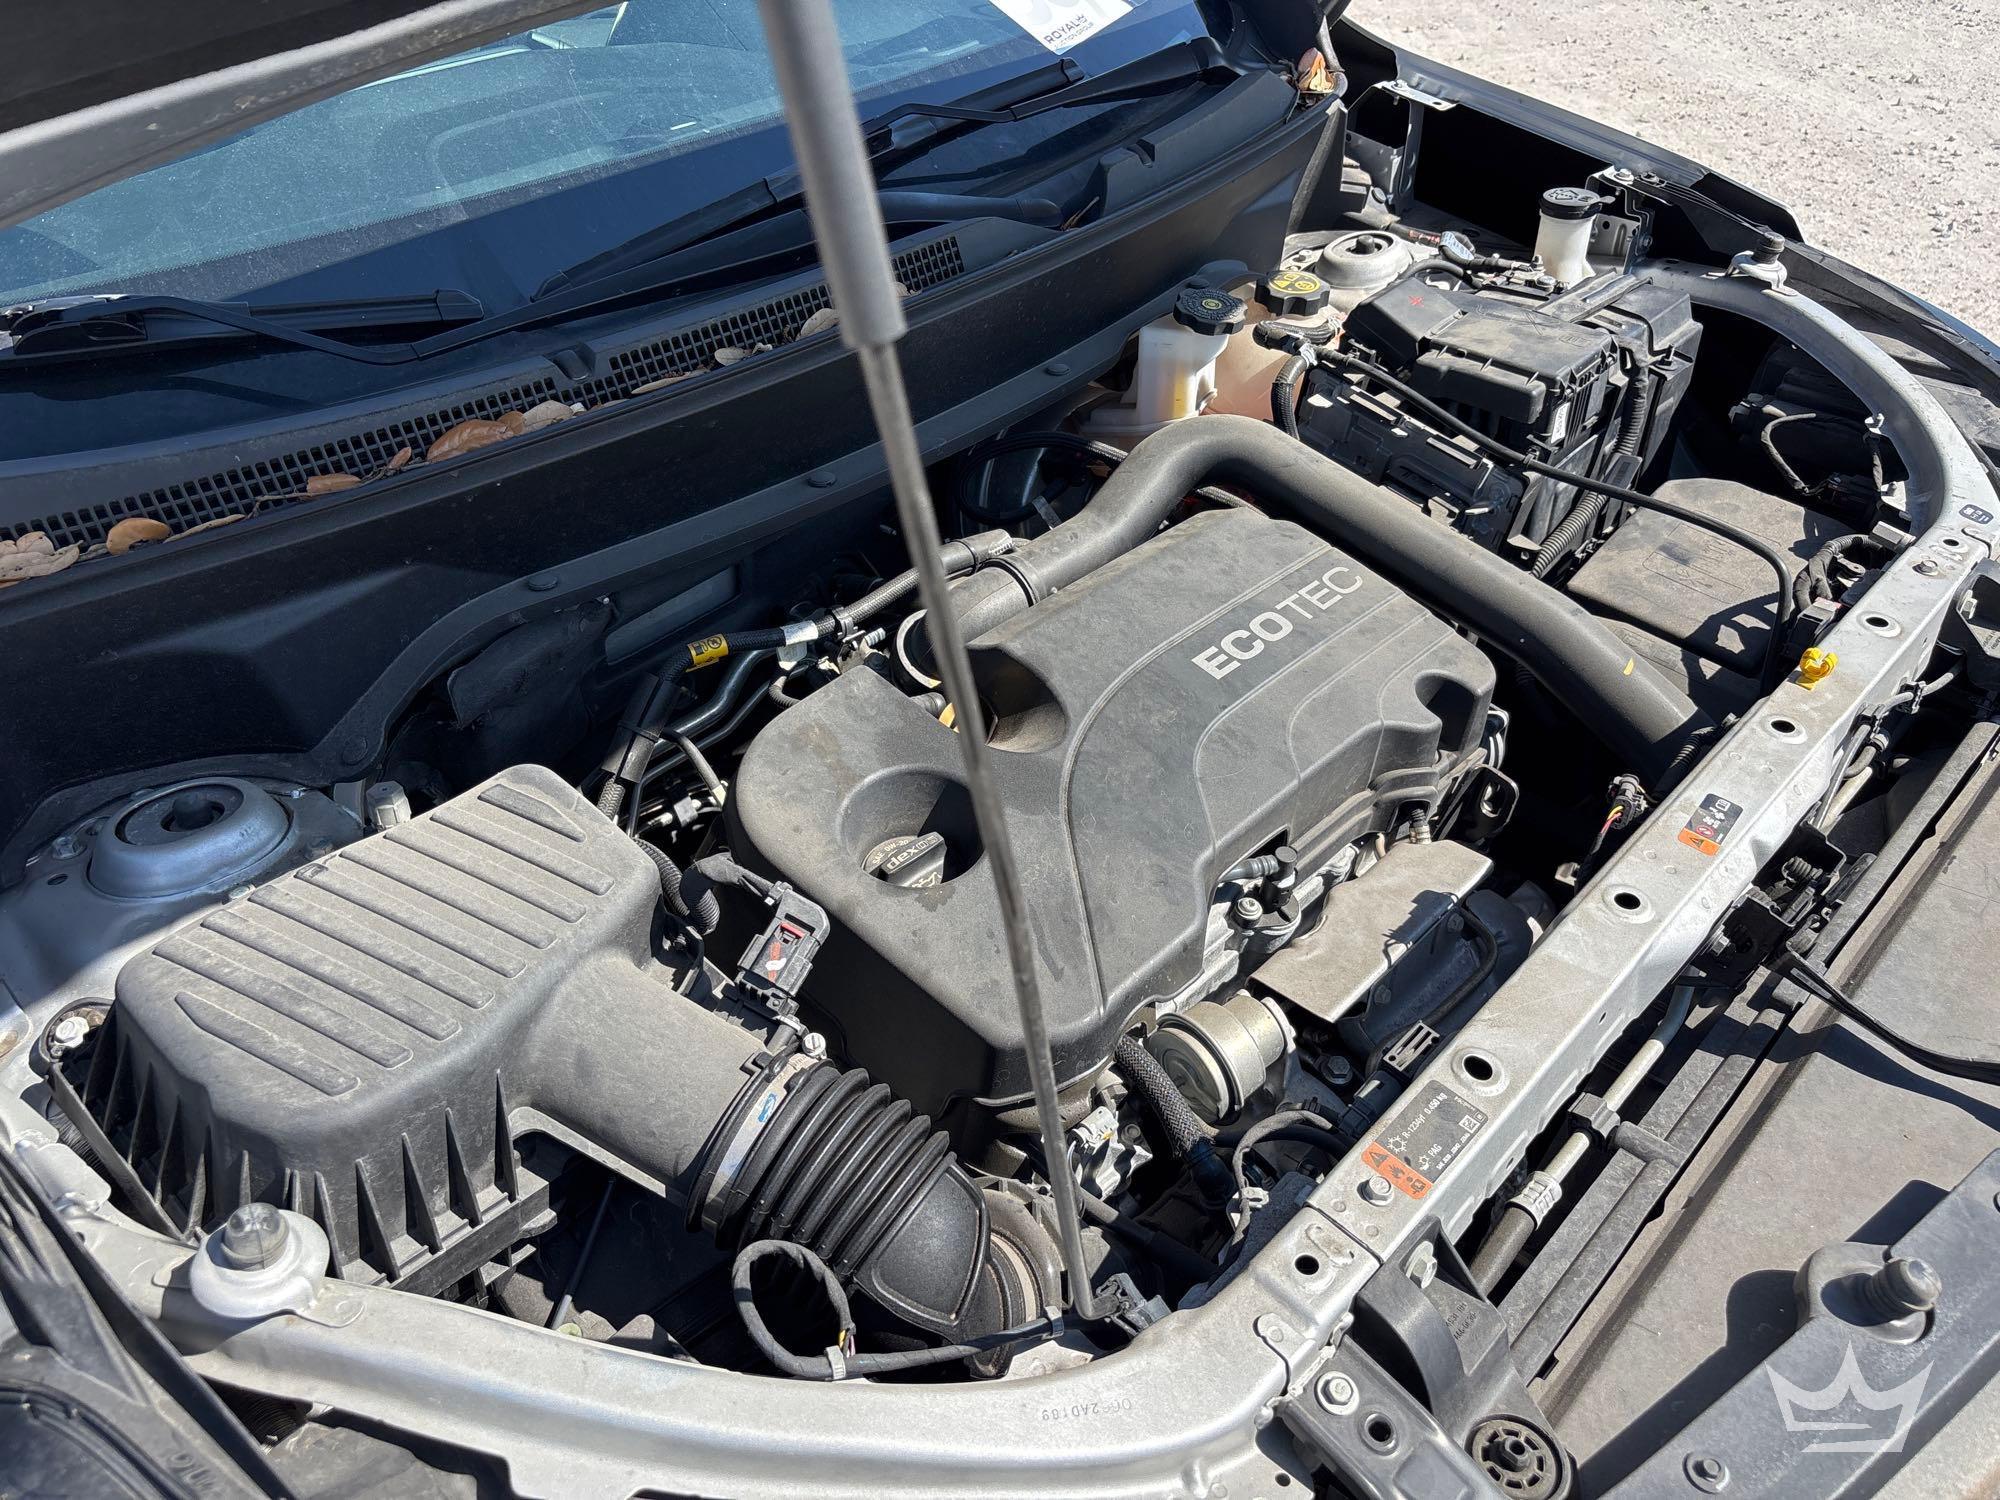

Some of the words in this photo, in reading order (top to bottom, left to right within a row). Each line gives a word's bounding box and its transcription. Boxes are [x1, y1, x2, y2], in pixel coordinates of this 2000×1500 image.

[1044, 21, 1080, 44] ROYAL
[1191, 566, 1363, 680] ECOTEC
[1435, 1092, 1448, 1102] kg
[1427, 1143, 1443, 1157] PAG
